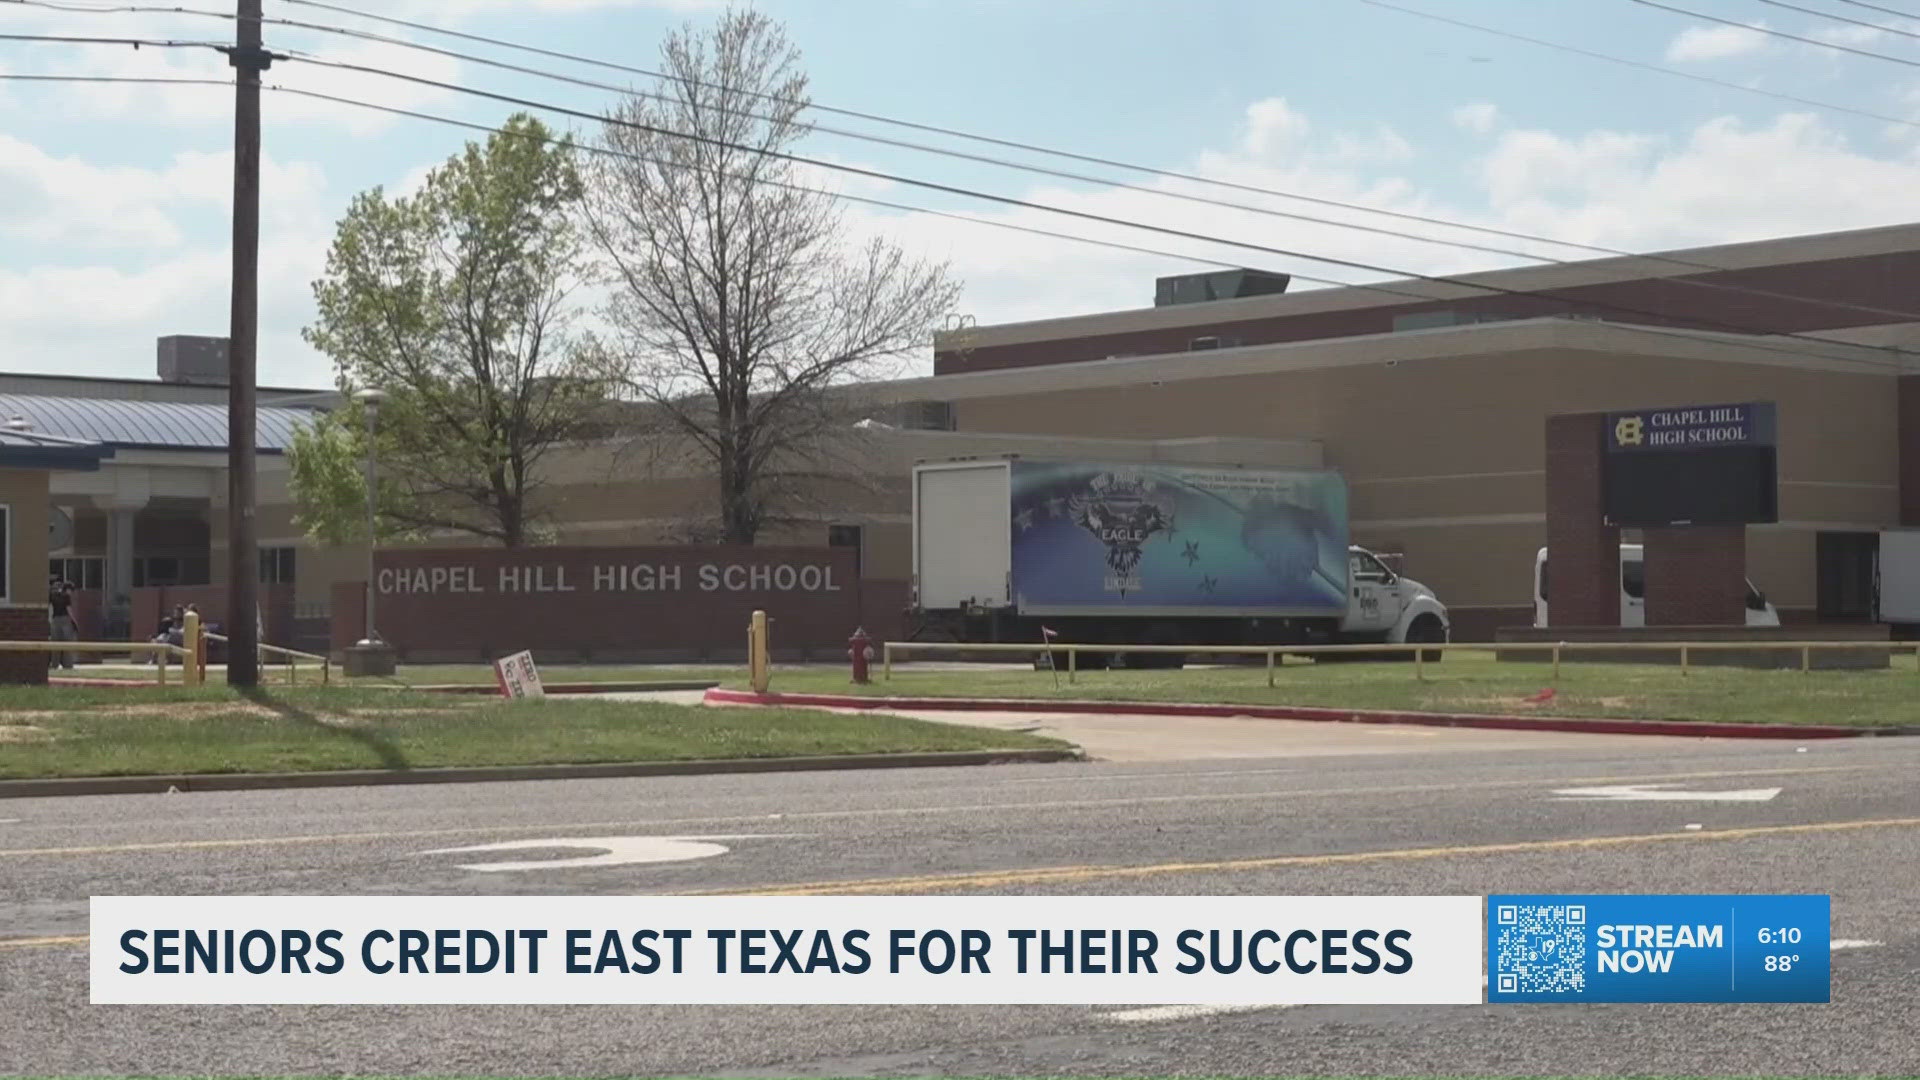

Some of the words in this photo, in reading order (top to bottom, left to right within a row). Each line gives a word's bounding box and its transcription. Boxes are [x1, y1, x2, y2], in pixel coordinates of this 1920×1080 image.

[1651, 411, 1707, 427] CHAPEL
[1710, 407, 1745, 423] HILL
[1650, 429, 1685, 445] HIGH
[1688, 426, 1747, 443] SCHOOL
[1101, 528, 1143, 541] EAGLE
[378, 567, 483, 594] CHAPEL
[499, 566, 575, 592] HILL
[594, 564, 681, 591] HIGH
[699, 563, 840, 591] SCHOOL
